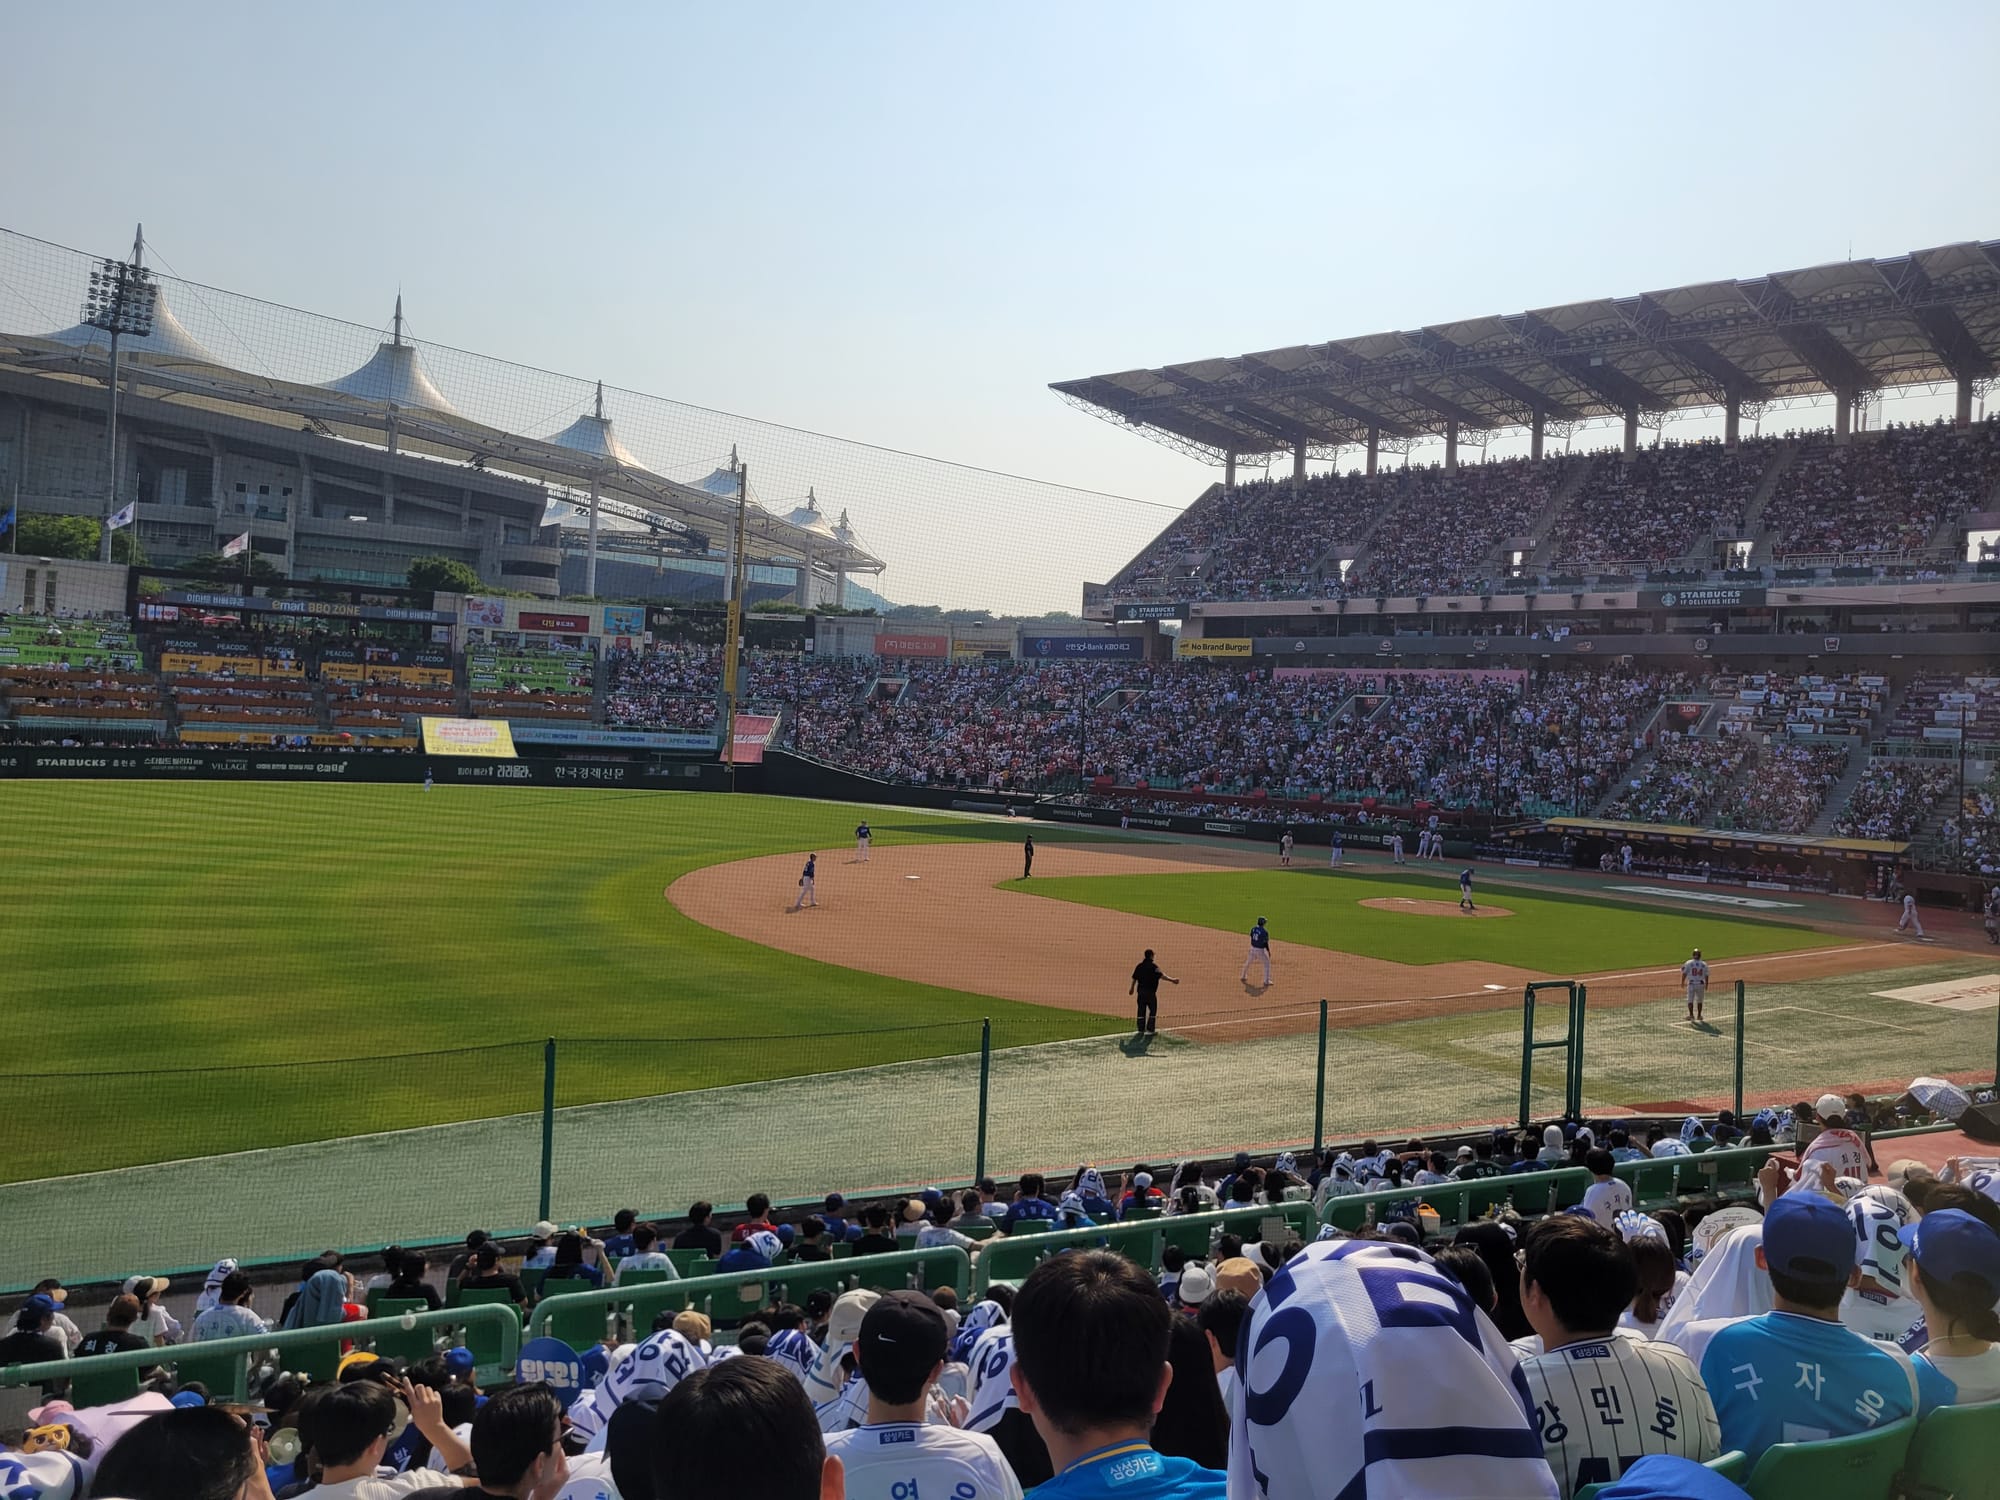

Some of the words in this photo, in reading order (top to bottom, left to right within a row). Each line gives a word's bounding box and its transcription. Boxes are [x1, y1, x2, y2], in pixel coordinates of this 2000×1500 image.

[1680, 591, 1741, 599] STARBUCKS
[272, 600, 305, 611] emart
[308, 602, 331, 614] BBQ
[334, 604, 360, 616] ZONE
[165, 640, 198, 648] PEACOCK
[217, 643, 249, 651] PEACOCK
[1225, 643, 1249, 652] Burger
[1681, 705, 1697, 713] 104
[37, 759, 106, 767] STARBUCKS
[212, 762, 248, 771] VILLAGE
[555, 766, 625, 780] 한국경제신문
[1575, 1346, 1607, 1358] 삼성카드
[1731, 1362, 1885, 1427] 구자욱
[883, 1430, 912, 1442] 삼성카드
[1110, 1456, 1158, 1480] 삼성카드
